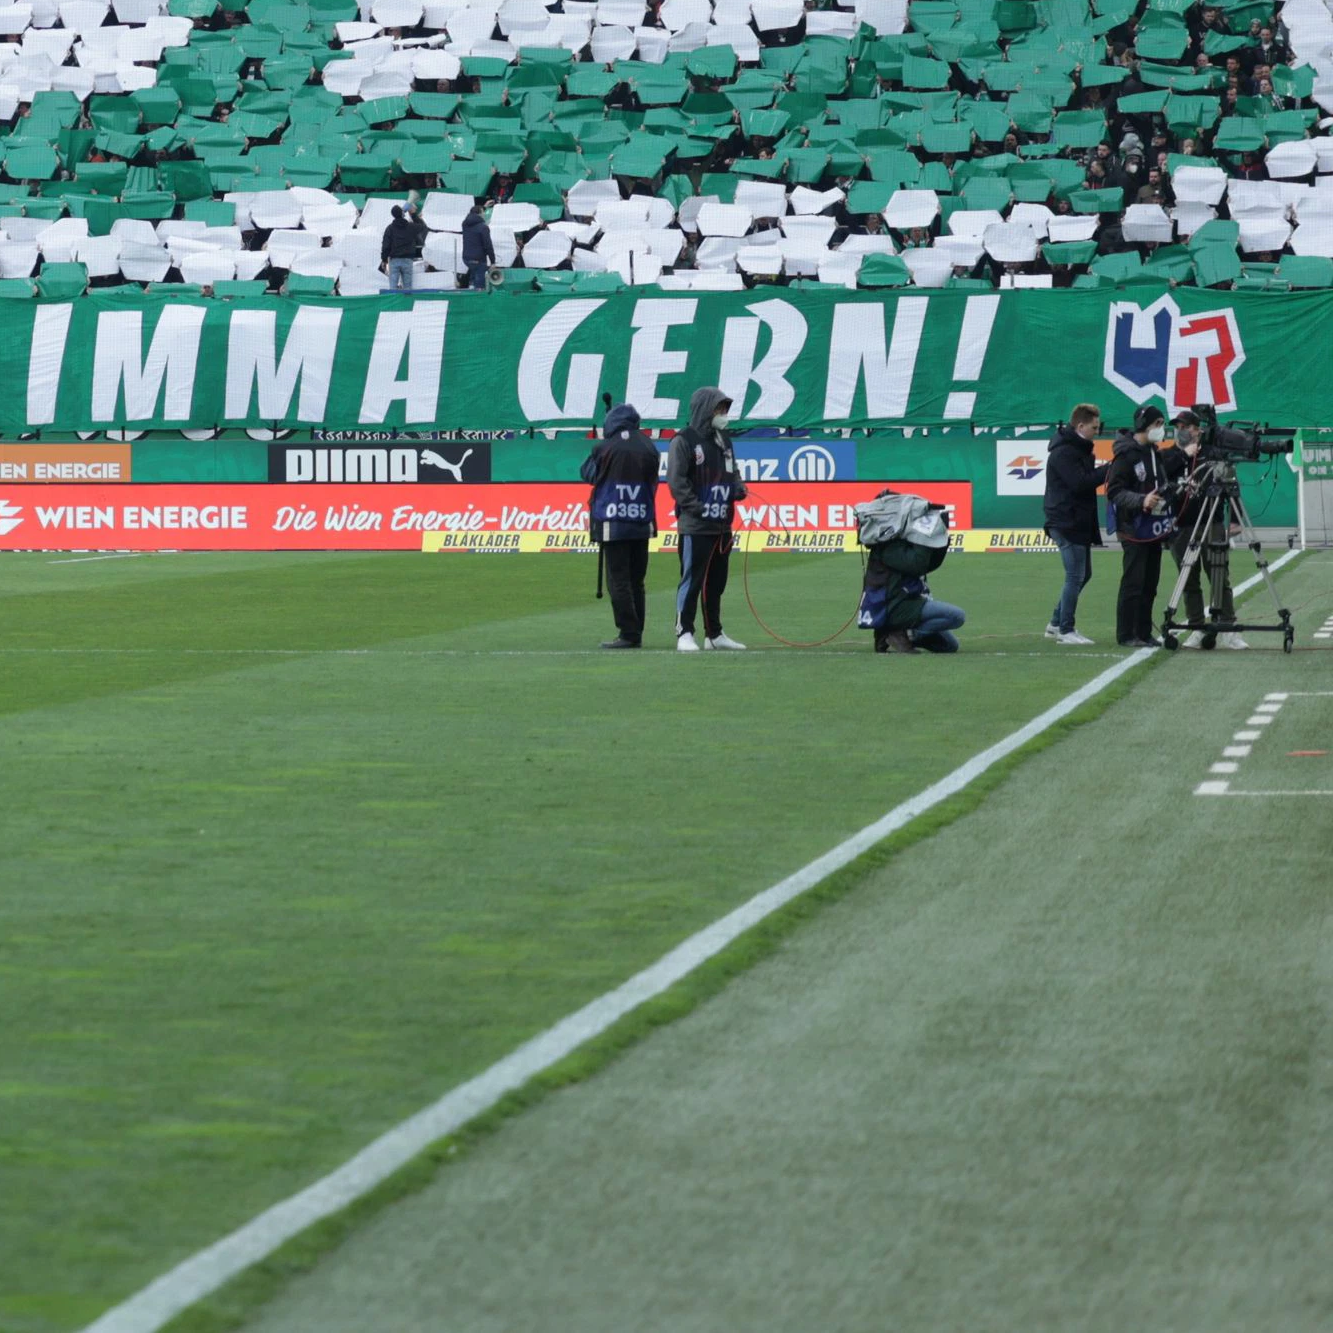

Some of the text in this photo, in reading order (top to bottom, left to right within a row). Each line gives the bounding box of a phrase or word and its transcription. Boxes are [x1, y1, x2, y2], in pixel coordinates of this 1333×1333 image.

[26, 300, 448, 424] IMMA
[517, 296, 1001, 422] GEBN!
[34, 463, 120, 479] ENERGIE
[285, 448, 418, 482] PUMA
[615, 484, 641, 500] TV
[35, 506, 248, 529] WIEN ENERGIE
[272, 504, 317, 532] Die
[324, 505, 382, 531] Wien
[606, 503, 647, 518] 0365
[736, 505, 818, 528] WIEN
[443, 531, 521, 546] BLÅKLÄDER
[766, 530, 844, 546] BLÅKLÄDER
[990, 530, 1057, 546] BLÅKLÄD
